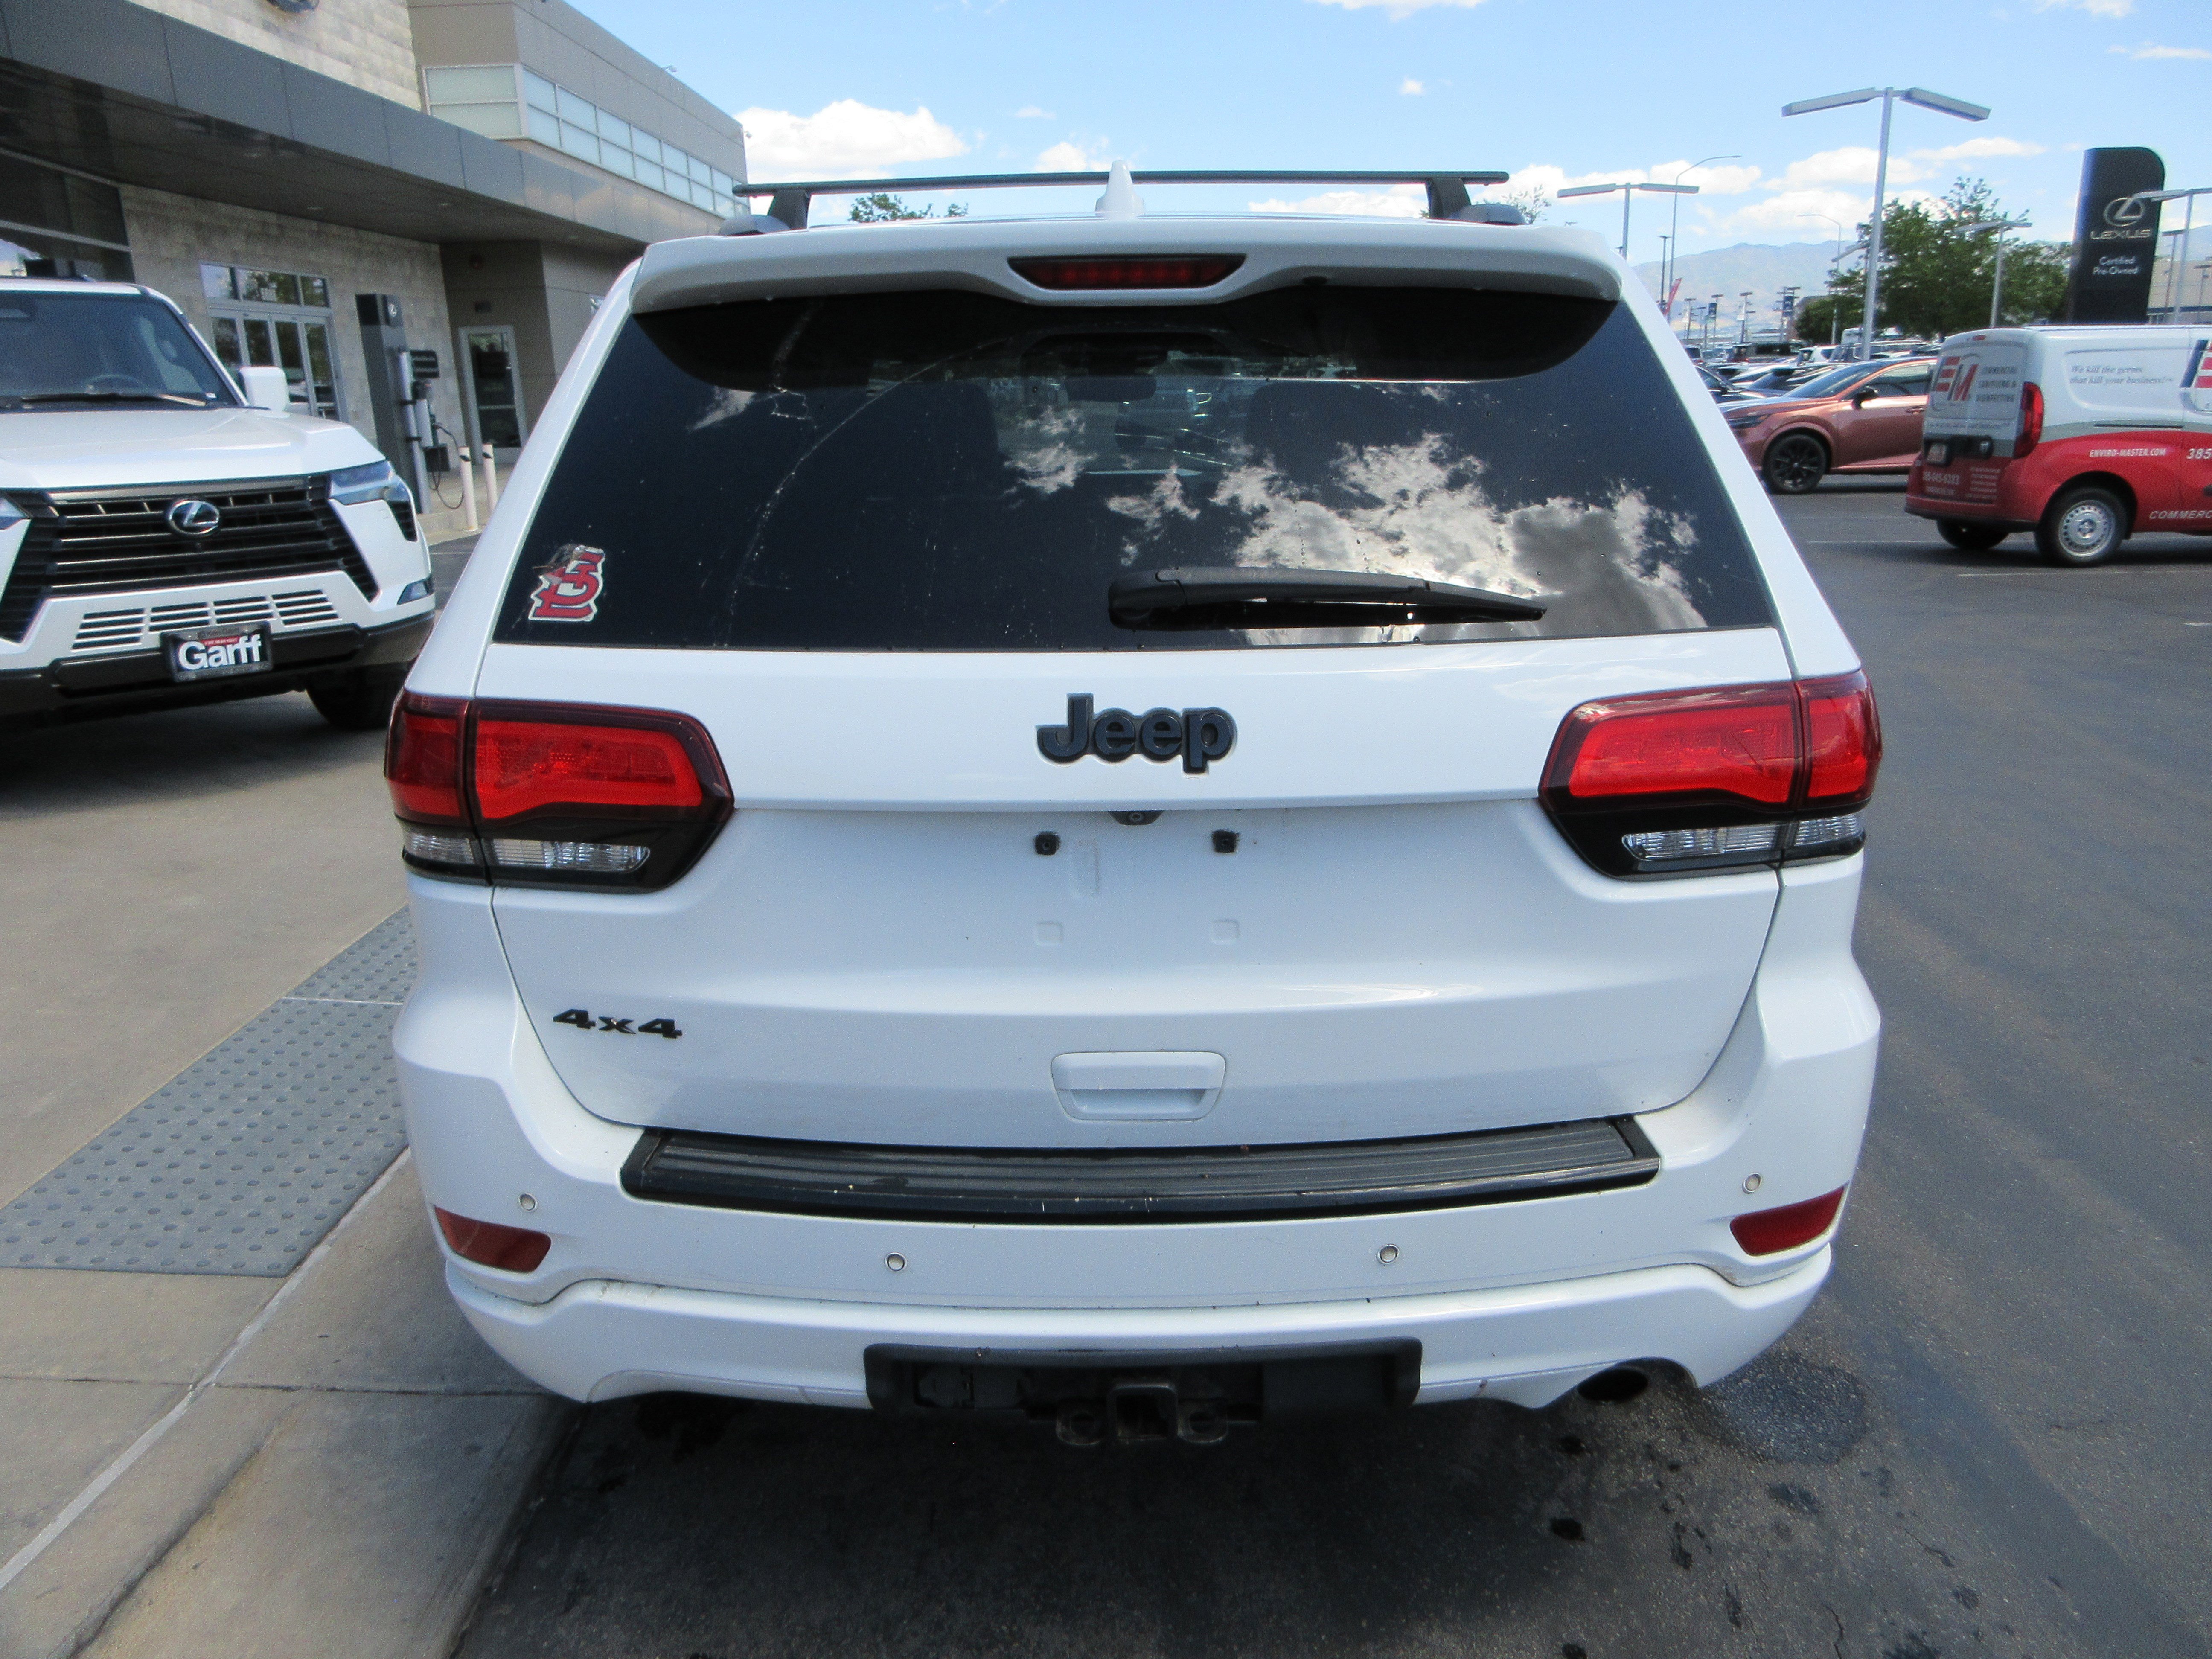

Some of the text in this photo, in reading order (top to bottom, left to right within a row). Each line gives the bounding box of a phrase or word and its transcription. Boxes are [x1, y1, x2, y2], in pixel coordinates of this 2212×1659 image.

[2090, 229, 2152, 239] LEXUS
[2099, 256, 2136, 265] Certified
[2090, 448, 2167, 457] ENVIRO-MASTER.COM
[178, 634, 261, 670] Garff
[1036, 693, 1238, 775] Jeep
[553, 1009, 683, 1039] 4x4
